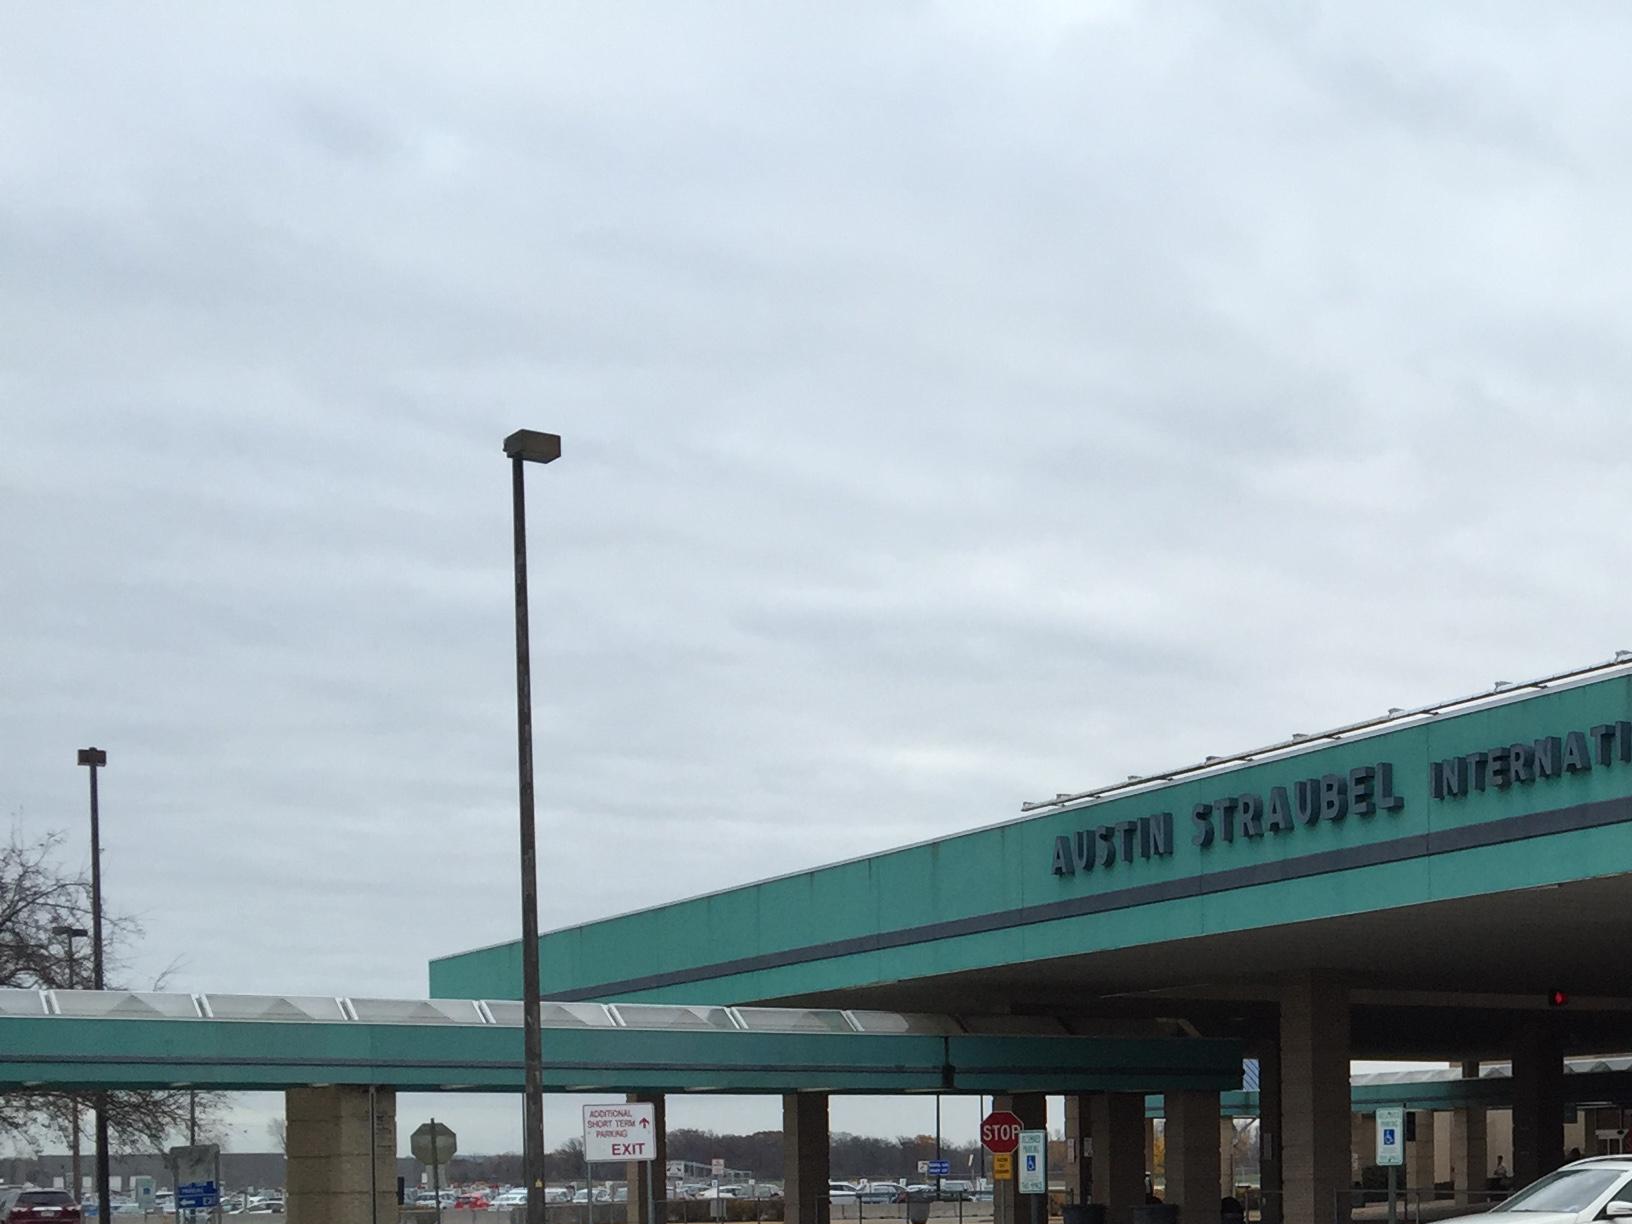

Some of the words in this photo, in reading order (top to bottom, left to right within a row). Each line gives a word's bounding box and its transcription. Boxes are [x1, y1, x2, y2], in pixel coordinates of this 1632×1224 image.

[1052, 812, 1173, 876] AUSTIN
[1191, 762, 1405, 850] STRAUBEL
[589, 1109, 632, 1118] ADDITIONAL
[587, 1119, 612, 1128] SHORT
[615, 1119, 636, 1128] TERM
[596, 1129, 628, 1138] PARKING
[983, 1124, 1020, 1141] STOP
[611, 1143, 645, 1156] EXIT
